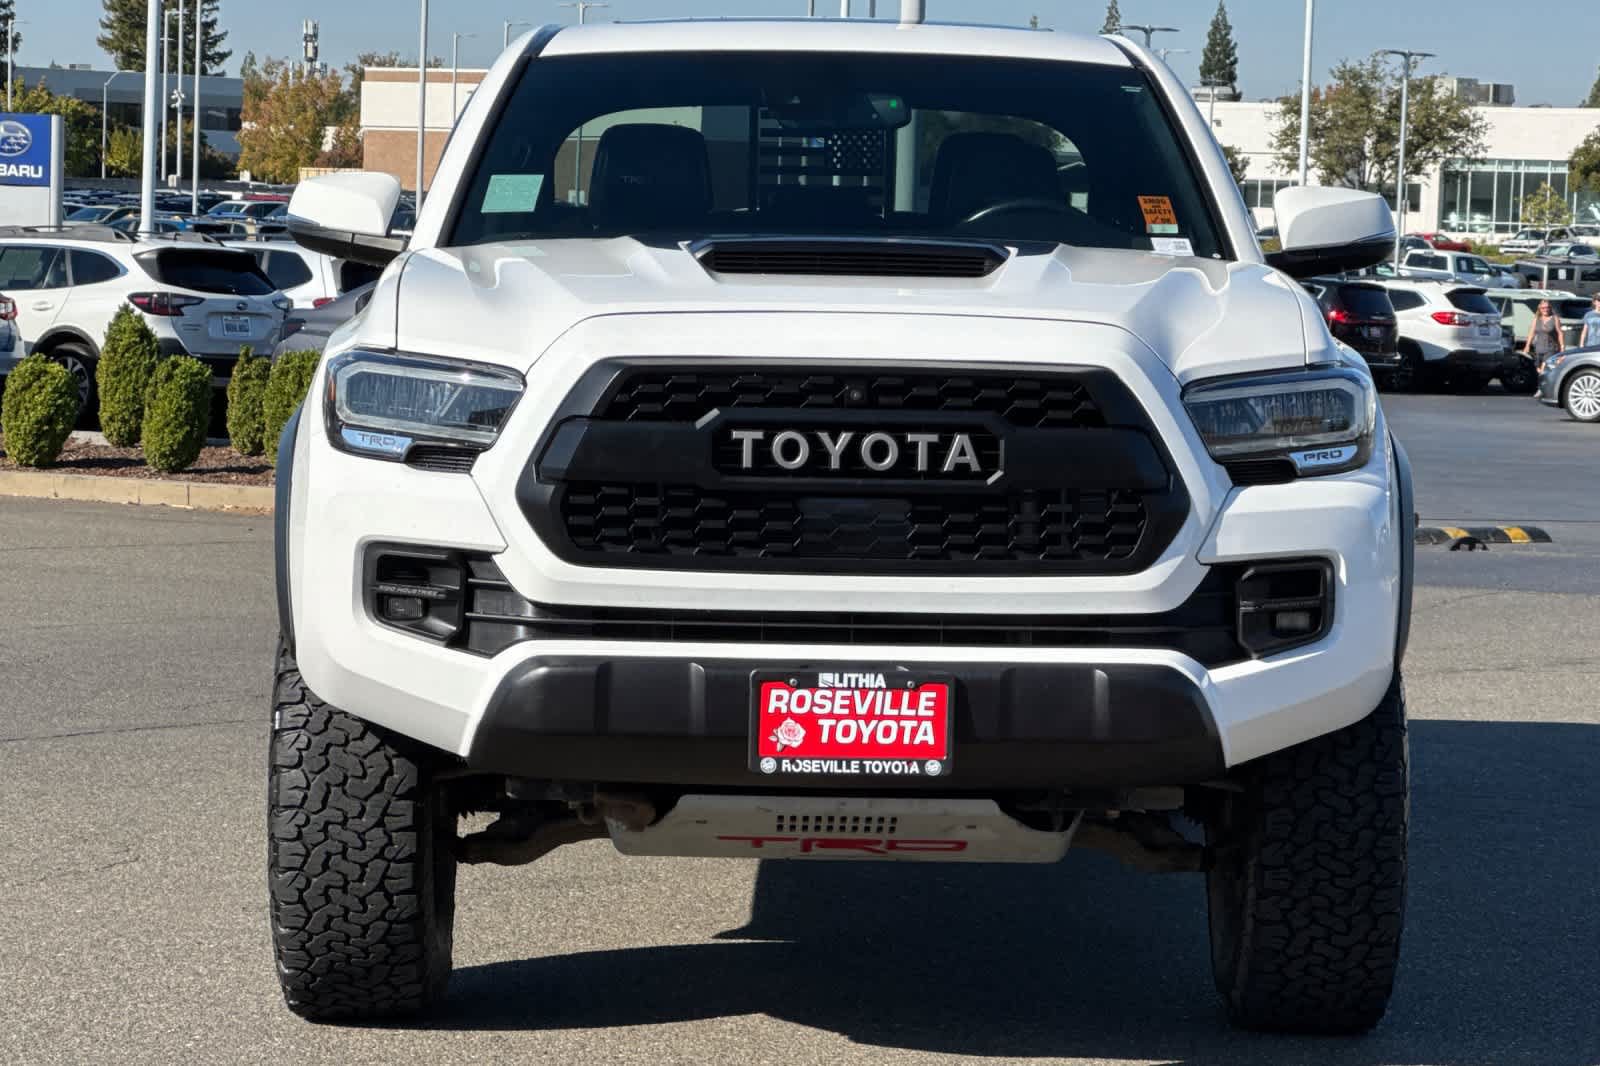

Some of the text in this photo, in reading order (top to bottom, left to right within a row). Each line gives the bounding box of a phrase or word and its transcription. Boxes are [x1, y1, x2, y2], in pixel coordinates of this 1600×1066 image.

[358, 433, 396, 447] TRD
[732, 430, 982, 472] TOYOTA
[1303, 450, 1343, 461] PRO
[834, 673, 886, 689] LITHIA
[767, 689, 937, 717] ROSEVILLE
[817, 719, 935, 745] TOYOTA
[781, 760, 860, 773] ROSEVILLE
[716, 836, 968, 854] TRD
